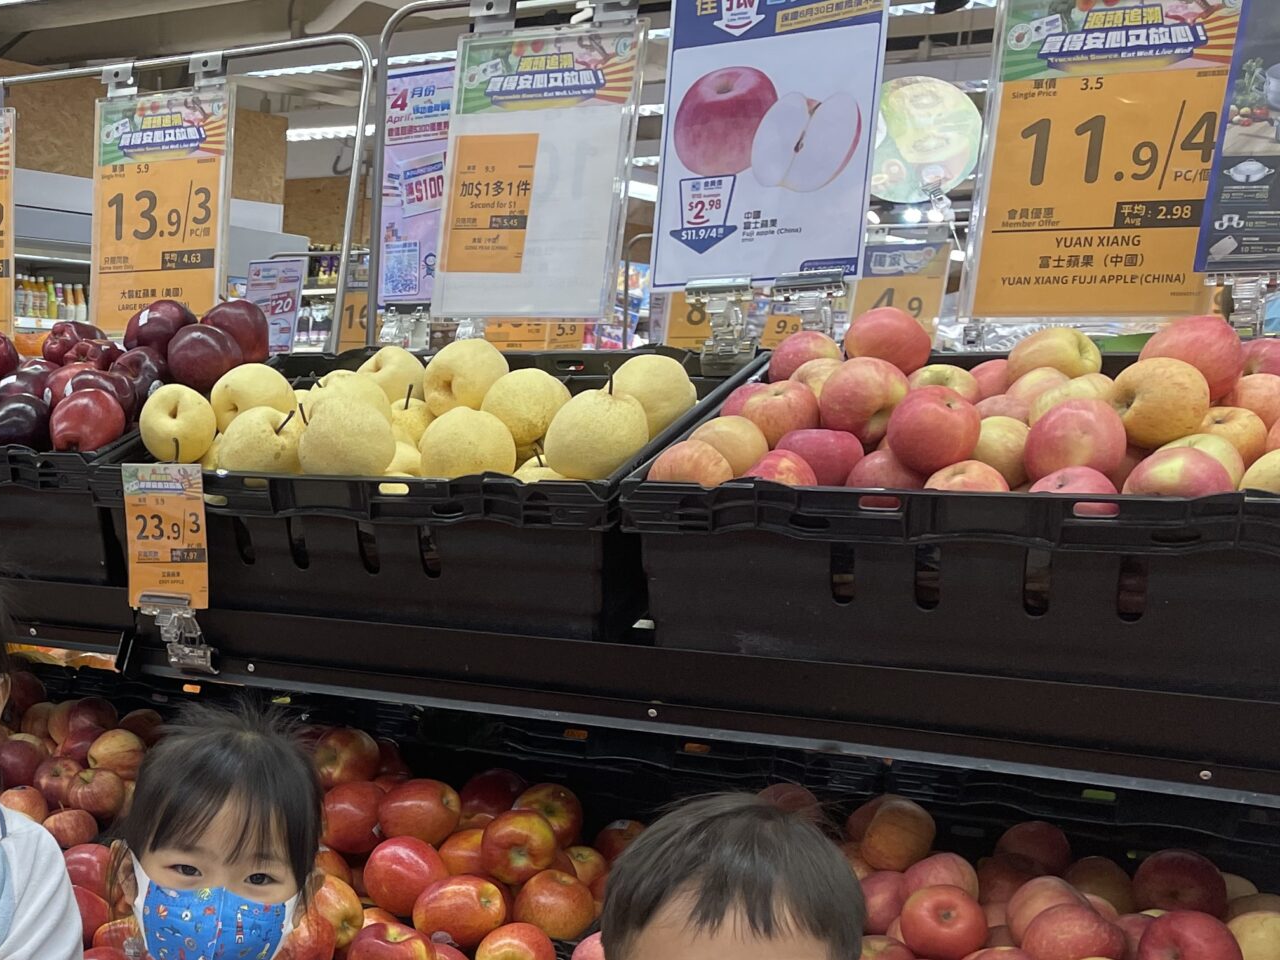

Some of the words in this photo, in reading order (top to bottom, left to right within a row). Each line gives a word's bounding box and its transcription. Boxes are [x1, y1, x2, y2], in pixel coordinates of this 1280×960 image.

[1084, 6, 1163, 30] 源頭追溯
[1080, 77, 1104, 91] 3.5
[390, 88, 409, 112] 4
[411, 84, 436, 99] 月份
[1011, 91, 1037, 99] Single
[1037, 90, 1057, 98] Price
[136, 163, 149, 174] 5.9
[460, 180, 531, 199] 加$1多1件
[470, 201, 495, 209] Second
[496, 201, 507, 209] for
[508, 200, 517, 209] $1
[687, 198, 722, 220] $2.98
[744, 210, 762, 220] 中國
[1007, 207, 1054, 220] 會員優惠
[1156, 205, 1192, 220] 2.98
[1001, 219, 1037, 228] Member
[1124, 217, 1141, 226] Avg
[742, 229, 755, 238] Fuji
[776, 226, 802, 236] (China)
[1055, 236, 1094, 249] YUAN
[1096, 235, 1141, 248] XIANG
[182, 253, 201, 263] 4.63
[1001, 276, 1031, 286] YUAN
[1033, 275, 1069, 286] XIANG
[1071, 274, 1098, 285] FUJI
[1099, 274, 1138, 285] APPLE
[1139, 272, 1186, 286] (CHINA)
[556, 323, 577, 338] 5.9
[775, 319, 800, 335] 9.9
